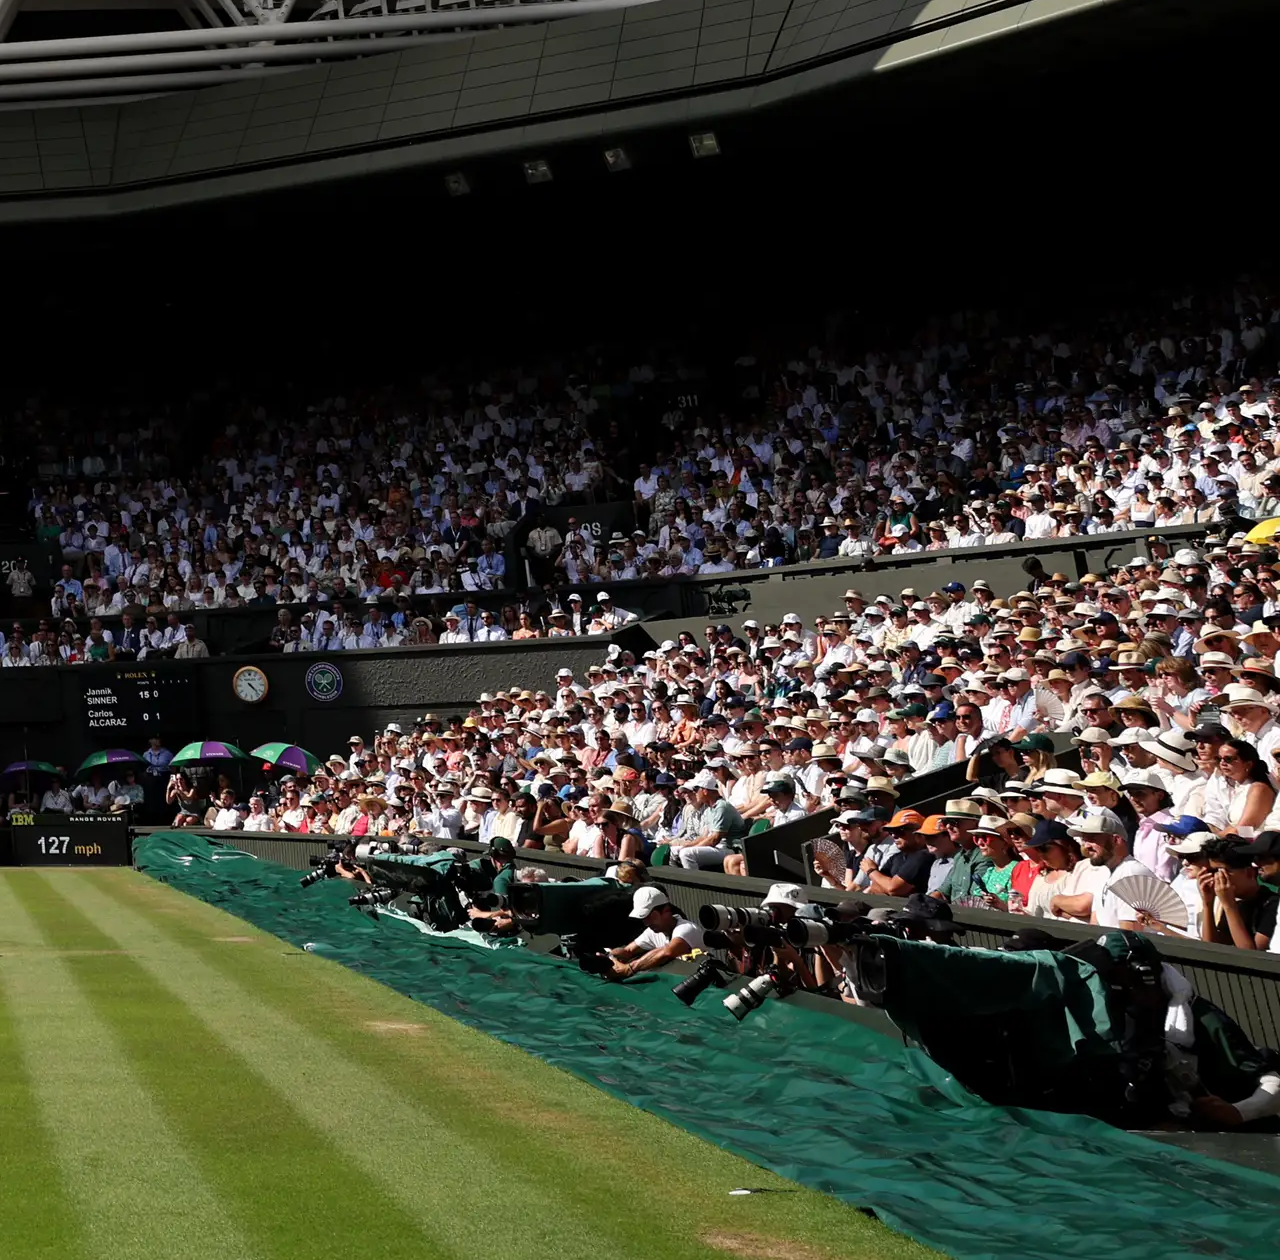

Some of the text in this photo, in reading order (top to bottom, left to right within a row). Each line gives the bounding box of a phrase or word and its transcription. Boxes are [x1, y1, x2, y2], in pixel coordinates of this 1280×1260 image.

[677, 393, 700, 409] 311
[1, 560, 28, 573] 20
[86, 688, 112, 696] Jannik
[89, 718, 127, 726] ALCARAZ
[11, 814, 35, 825] IBM
[38, 837, 101, 856] 127 mph
